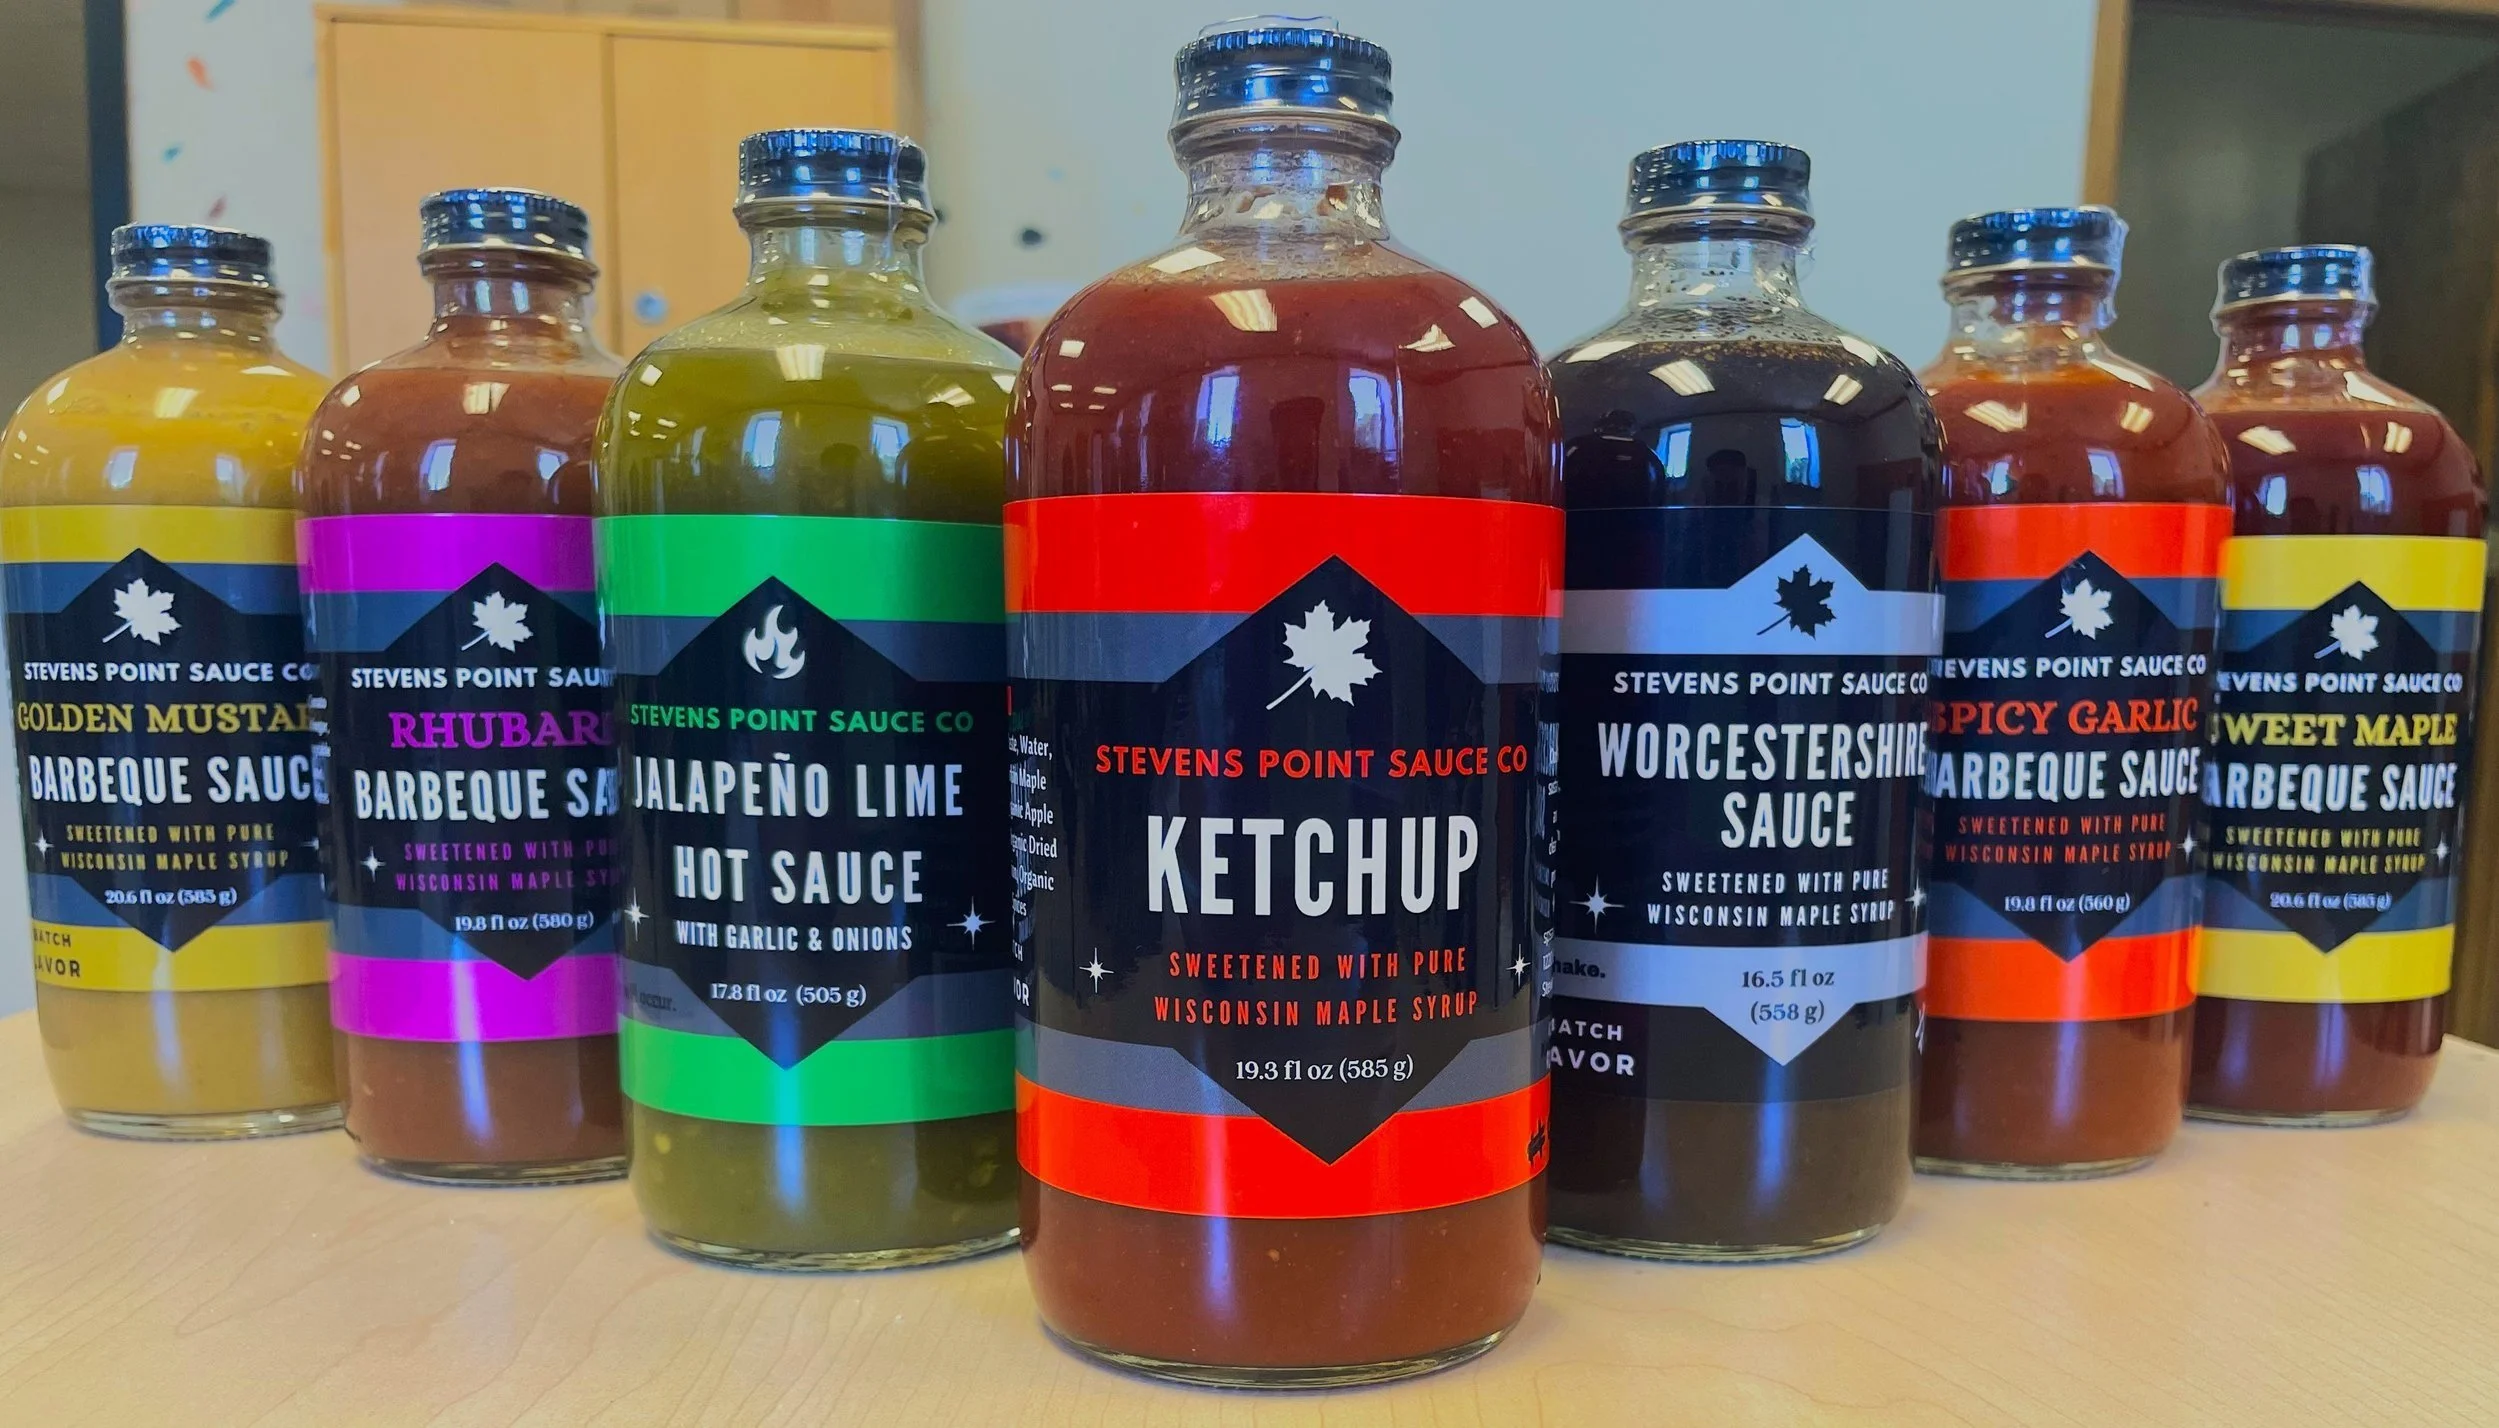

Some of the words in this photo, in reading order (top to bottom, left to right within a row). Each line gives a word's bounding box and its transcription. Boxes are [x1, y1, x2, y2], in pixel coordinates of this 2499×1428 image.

[24, 662, 99, 682] STEVENS
[105, 662, 181, 682] POINT
[189, 662, 274, 682] SAUCE
[351, 667, 449, 689] STEVENS
[456, 667, 538, 689] POINT
[548, 666, 617, 688] SAU
[1929, 657, 2027, 679] EVENS
[2036, 656, 2113, 679] POINT
[2119, 655, 2182, 677] SAUCE
[2187, 654, 2206, 675] CO
[1613, 671, 1739, 695] STEVENS
[1750, 672, 1833, 695] POINT
[1841, 672, 1905, 694] SAUCE
[1910, 672, 1927, 694] CO
[2216, 671, 2298, 692] EVENS
[2305, 673, 2377, 693] POINT
[2382, 672, 2441, 693] SAUCE
[2443, 672, 2463, 693] CO
[18, 702, 134, 733] GOLDEN
[630, 704, 720, 730] STEVENS
[731, 708, 818, 732] POINT
[829, 711, 925, 732] SAUCE
[935, 711, 974, 732] CO
[2068, 697, 2199, 735] GARLIC
[2205, 712, 2346, 746] WEET
[2353, 712, 2458, 746] MAPLE
[1020, 734, 1053, 760] Water,
[1598, 721, 1927, 781] WORCESTERSHIRE
[1095, 745, 1244, 778] STEVENS
[1259, 749, 1375, 778] POINT
[1388, 747, 1489, 778] SAUCE
[1497, 745, 1528, 773] CO
[1925, 751, 2107, 802] ARBEQUE
[2119, 747, 2201, 798] SAUCE
[28, 755, 192, 806] BARBEQUE
[632, 752, 829, 818] JALAPEÑO
[856, 764, 963, 817] LIME
[1019, 767, 1047, 794] Maple
[2202, 761, 2370, 814] ARBEQUE
[2380, 762, 2458, 812] SAUCE
[354, 769, 550, 824] BARBEQUE
[1024, 801, 1054, 828] Apple
[1720, 790, 1855, 849] SAUCE
[1959, 816, 2069, 836] SWEETENED
[2081, 815, 2122, 834] WITH
[2132, 812, 2166, 833] PURE
[65, 824, 158, 843] SWEETENED
[168, 825, 216, 843] WITH
[226, 823, 275, 842] PURE
[2225, 827, 2331, 848] SWEETENED
[2340, 828, 2381, 848] WITH
[2387, 828, 2421, 848] PURE
[404, 842, 512, 862] SWEETENED
[525, 840, 574, 861] WITH
[1028, 835, 1058, 858] Dried
[1945, 844, 2053, 863] WISCONSIN
[2064, 843, 2120, 864] MAPLE
[2129, 840, 2172, 861] SYRUP
[60, 852, 146, 871] WISCONSIN
[156, 852, 218, 871] MAPLE
[228, 849, 289, 870] SYRUP
[1147, 815, 1479, 917] KETCHUP
[2212, 853, 2316, 874] WISCONSIN
[2324, 855, 2378, 874] MAPLE
[2384, 854, 2427, 874] SYRUP
[395, 874, 499, 892] WISCONSIN
[511, 870, 575, 890] MAPLE
[674, 845, 749, 902] HOT
[771, 850, 923, 905] SAUCE
[1019, 864, 1055, 891] Organic
[1662, 871, 1785, 894] SWEETENED
[1798, 871, 1842, 893] WITH
[1853, 868, 1888, 890] PURE
[104, 889, 138, 905] 20.6
[139, 889, 153, 905] fl
[155, 892, 175, 905] oz
[177, 887, 217, 907] (585
[218, 887, 238, 907] g)
[2004, 895, 2035, 912] 19.8
[2040, 894, 2052, 912] fl
[2056, 898, 2075, 912] oz
[2079, 893, 2113, 914] (560
[2116, 891, 2130, 913] g)
[2322, 895, 2341, 909] oz
[455, 916, 487, 932] 19.8
[491, 915, 505, 931] fl
[508, 916, 529, 930] oz
[532, 913, 573, 931] (580
[577, 911, 594, 931] g)
[1647, 903, 1768, 927] WISCONSIN
[1780, 903, 1841, 926] MAPLE
[1850, 900, 1895, 923] SYRUP
[675, 920, 718, 947] WITH
[725, 925, 798, 950] GARLIC
[808, 927, 823, 951] &
[831, 926, 913, 951] ONIONS
[1169, 951, 1321, 981] SWEETENED
[1337, 952, 1399, 979] WITH
[1413, 947, 1466, 976] PURE
[1553, 957, 1606, 979] hake.
[1742, 971, 1784, 989] 16.5
[1790, 968, 1806, 988] fl
[1812, 970, 1835, 987] oz
[710, 982, 743, 1001] 17.8
[746, 983, 763, 1001] fl
[765, 988, 787, 1002] oz
[795, 984, 842, 1004] (505
[846, 984, 867, 1007] g)
[1154, 996, 1300, 1026] WISCONSIN
[1316, 998, 1398, 1026] MAPLE
[1412, 991, 1478, 1021] SYRUP
[1750, 1002, 1800, 1025] (558
[1804, 999, 1825, 1025] g)
[1235, 1060, 1279, 1081] 19.3
[1284, 1059, 1303, 1080] fl
[1307, 1063, 1334, 1081] oz
[1338, 1058, 1390, 1084] (585
[1393, 1054, 1414, 1082] g)
[1547, 1045, 1634, 1076] AVOR
